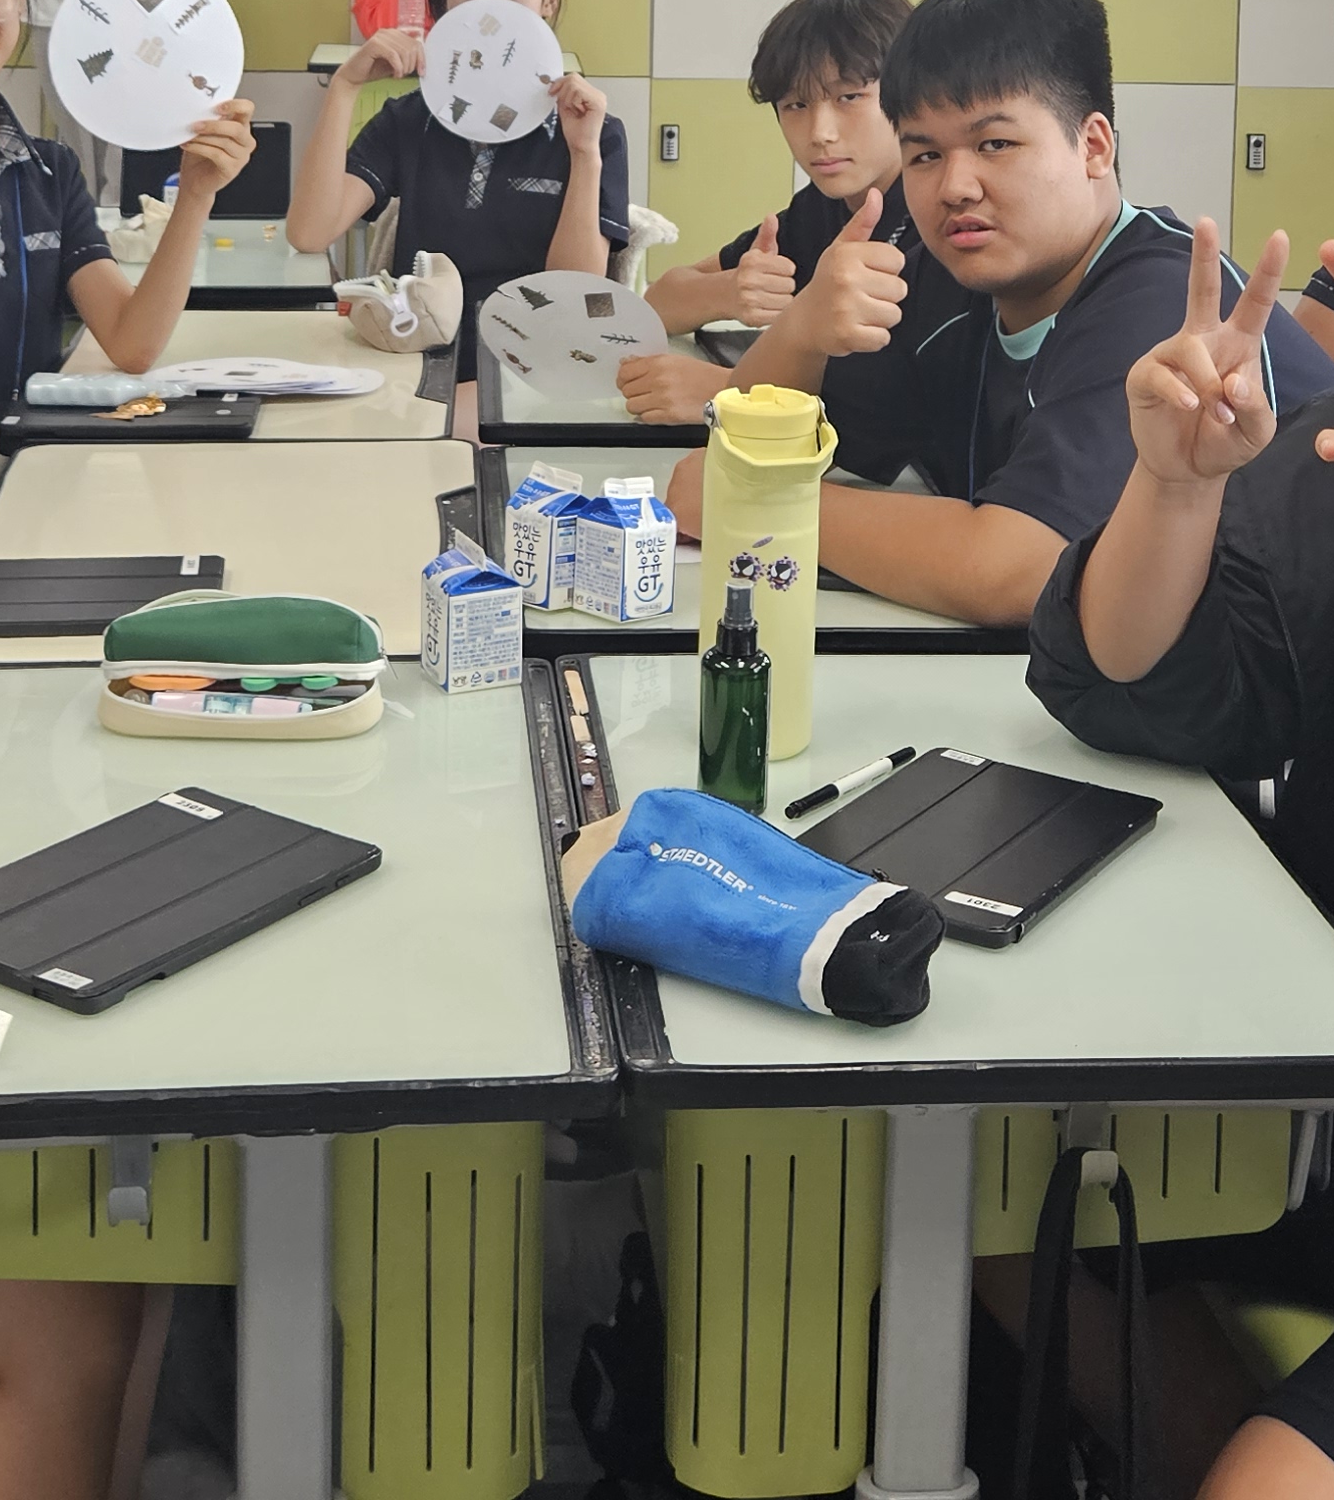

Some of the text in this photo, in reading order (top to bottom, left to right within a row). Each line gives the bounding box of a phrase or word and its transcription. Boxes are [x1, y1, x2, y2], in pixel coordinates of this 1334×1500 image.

[512, 521, 542, 543] 맛있는
[513, 540, 537, 562] 우유
[635, 536, 667, 555] 맛있는
[513, 560, 536, 579] GT
[637, 554, 663, 574] 우유
[637, 573, 661, 592] GT
[658, 847, 748, 893] STAEDTLER
